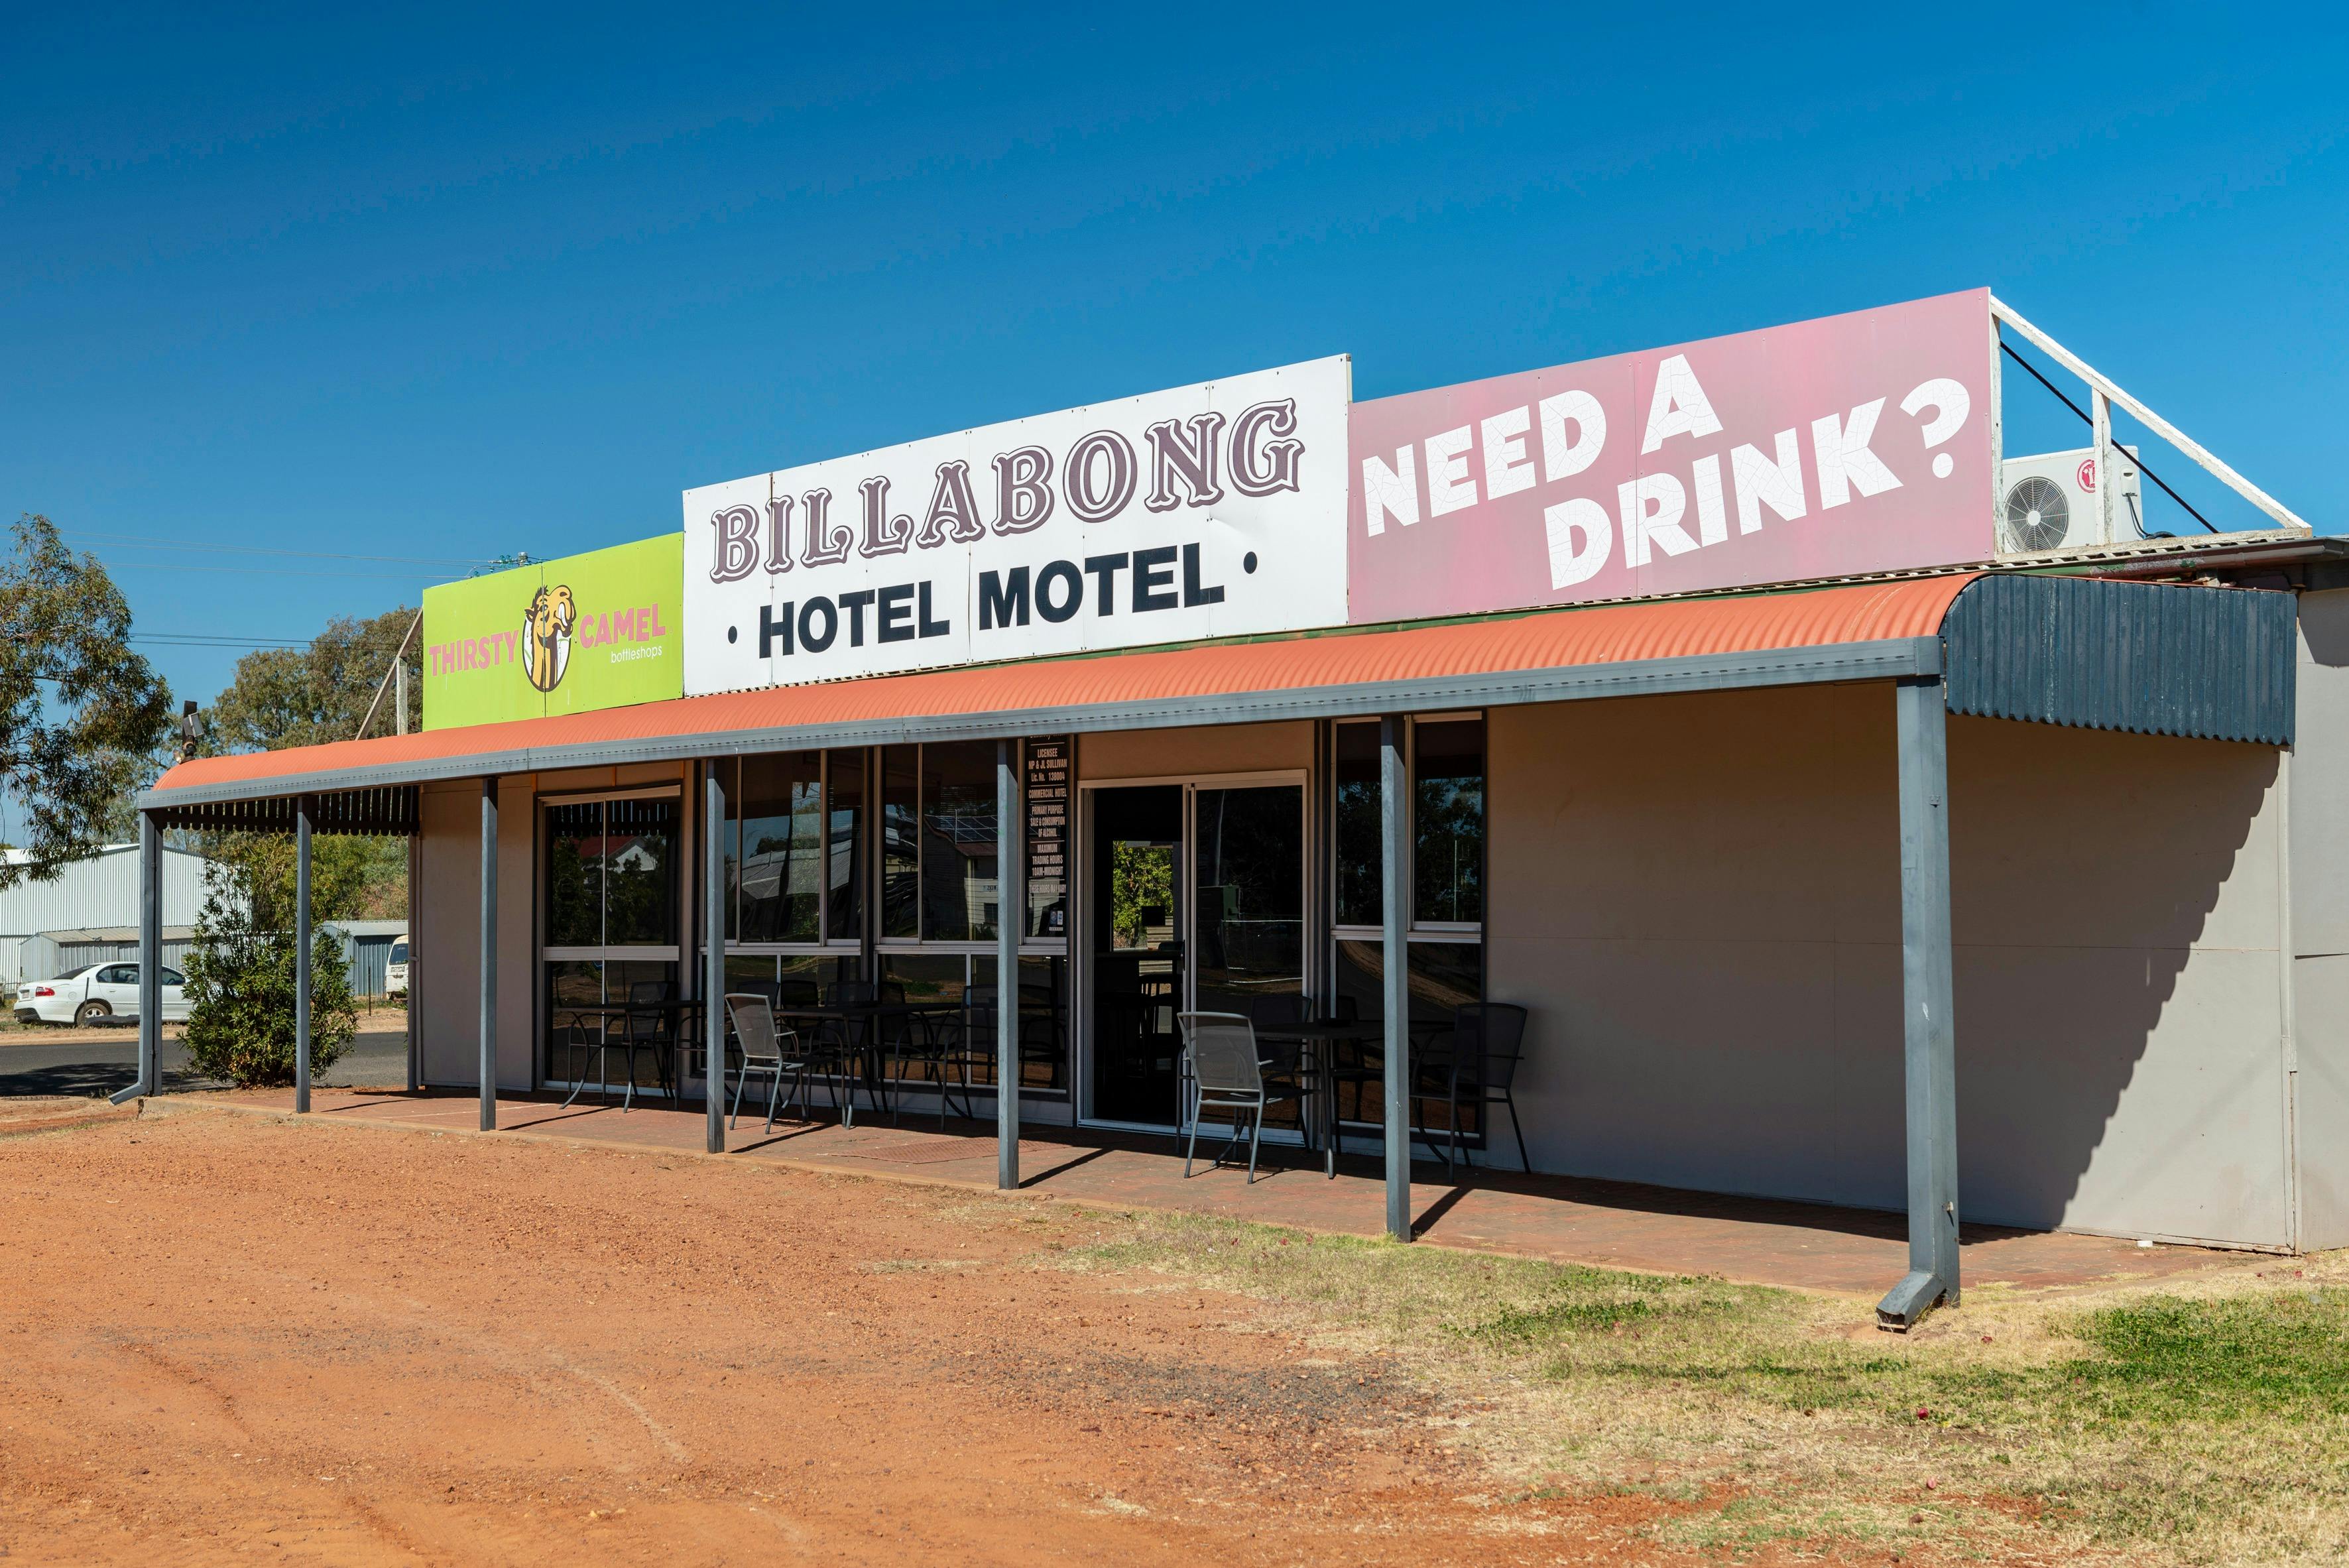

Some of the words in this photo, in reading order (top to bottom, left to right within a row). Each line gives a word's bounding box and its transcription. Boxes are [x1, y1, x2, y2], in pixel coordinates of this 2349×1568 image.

[1362, 390, 1607, 538] NEED
[1641, 353, 1724, 455] A
[1544, 377, 1971, 591] DRINK?
[709, 397, 1305, 583] BILLABONG
[759, 580, 950, 658] HOTEL
[979, 542, 1225, 631] MOTEL
[429, 630, 520, 676] THIRSTY
[579, 603, 666, 650] CAMEL
[611, 644, 662, 664] bottleshops
[1037, 748, 1058, 758] LICENSEE
[1028, 760, 1035, 770] NP
[1036, 760, 1040, 769] &
[1040, 759, 1046, 769] JL
[1046, 758, 1067, 768] SULLIVAN
[1028, 788, 1054, 799] COMMERCIAL
[1054, 788, 1067, 798] HOTEL
[1032, 806, 1048, 815] PRIMARY
[1048, 804, 1064, 815] PURPOSE
[1030, 817, 1039, 827] SALE
[1042, 816, 1065, 826] CONSUMPTION
[1038, 828, 1043, 838] OF
[1043, 827, 1057, 837] ALCOHOL
[1037, 843, 1058, 853] MAXIMUM
[1032, 855, 1050, 865] TRADING
[1050, 855, 1063, 864] HOURS
[1032, 866, 1063, 876] 10AM-MIDNIGHT
[1039, 884, 1050, 894] HOURS
[1057, 884, 1067, 893] VARY
